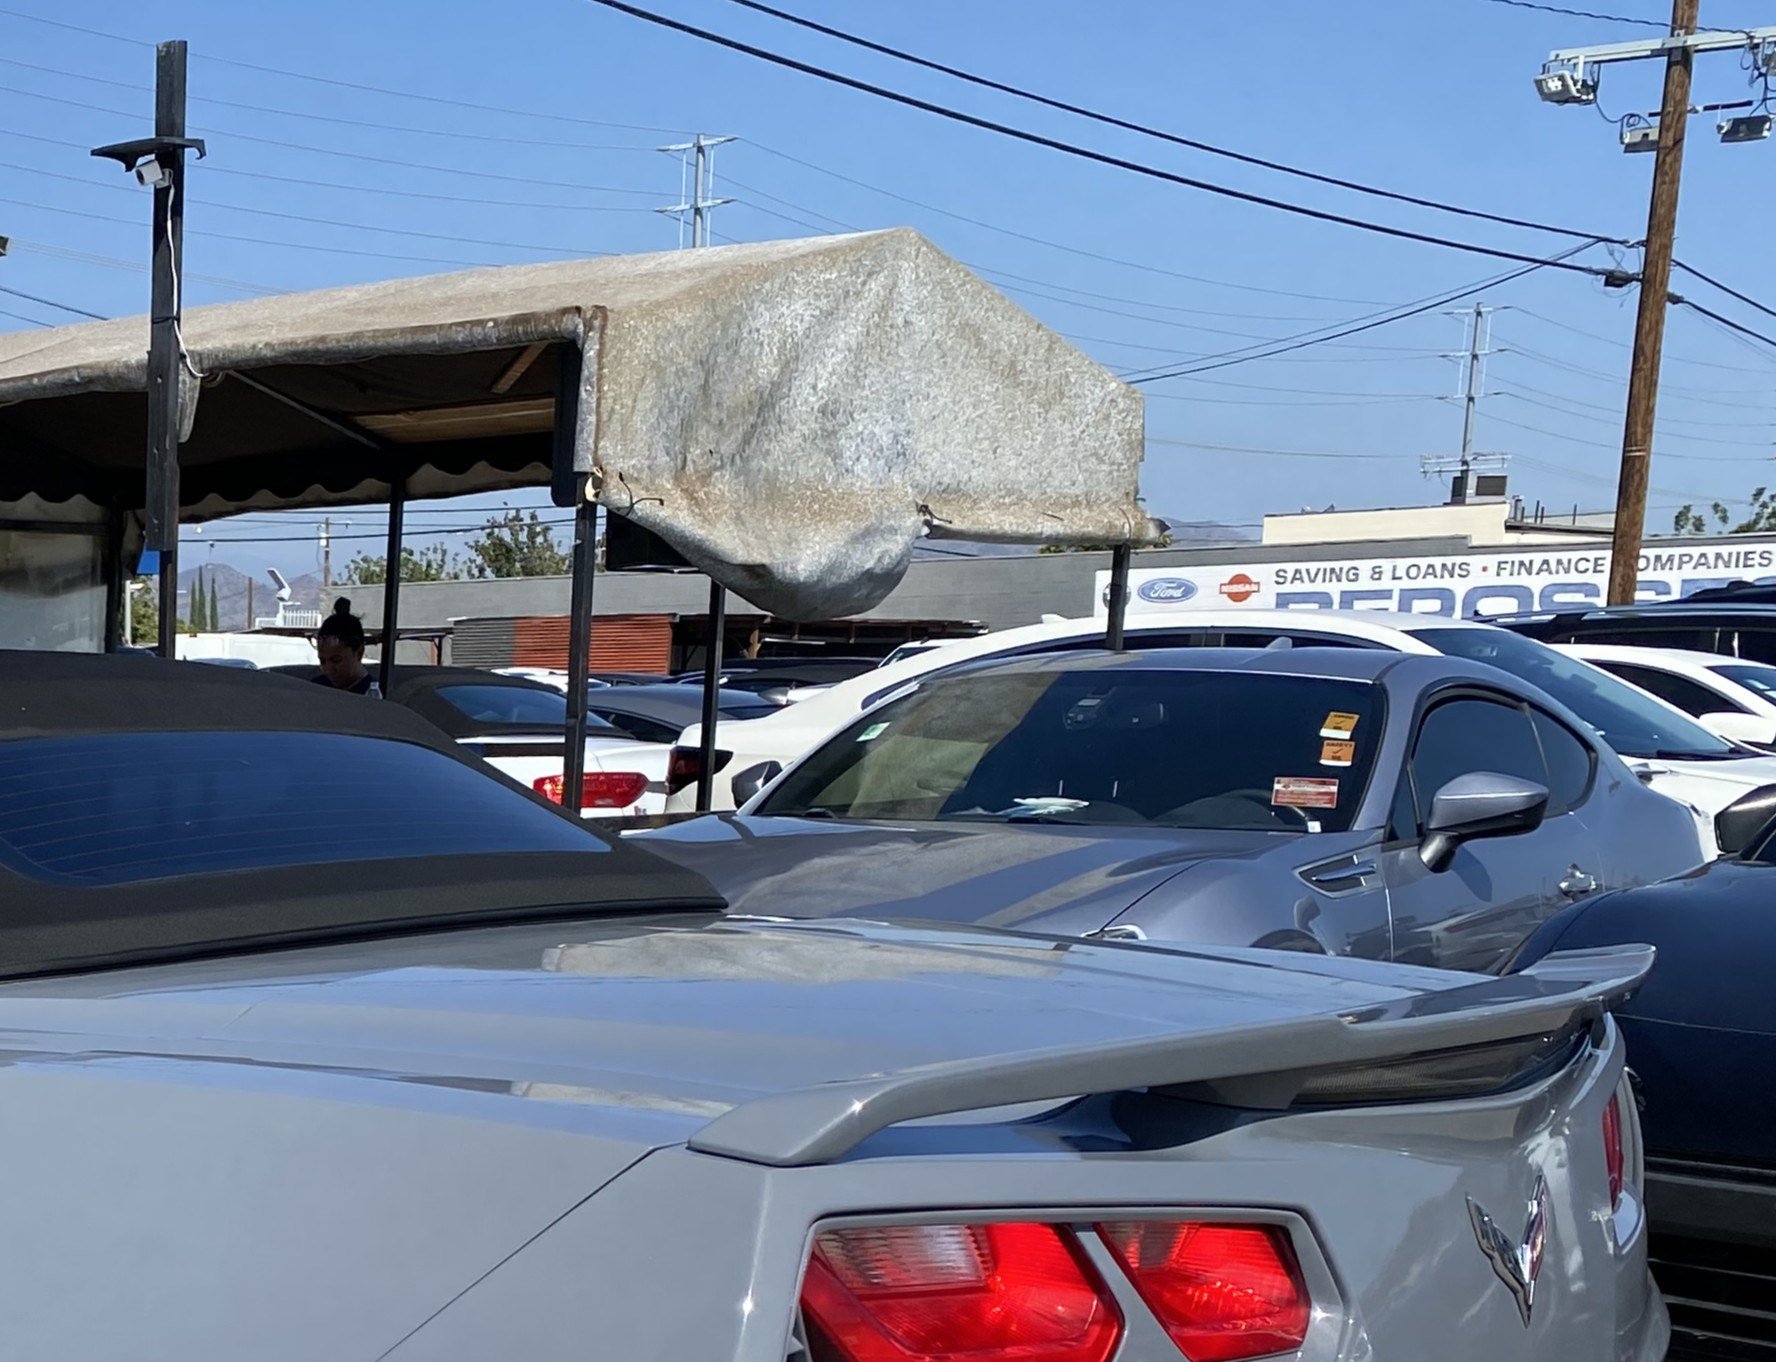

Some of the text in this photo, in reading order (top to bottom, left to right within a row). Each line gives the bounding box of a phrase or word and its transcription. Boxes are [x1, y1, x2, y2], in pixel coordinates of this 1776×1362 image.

[1275, 550, 1773, 585] SAVING & LOANS FINANCE OMPANIES
[1150, 580, 1183, 599] Ford
